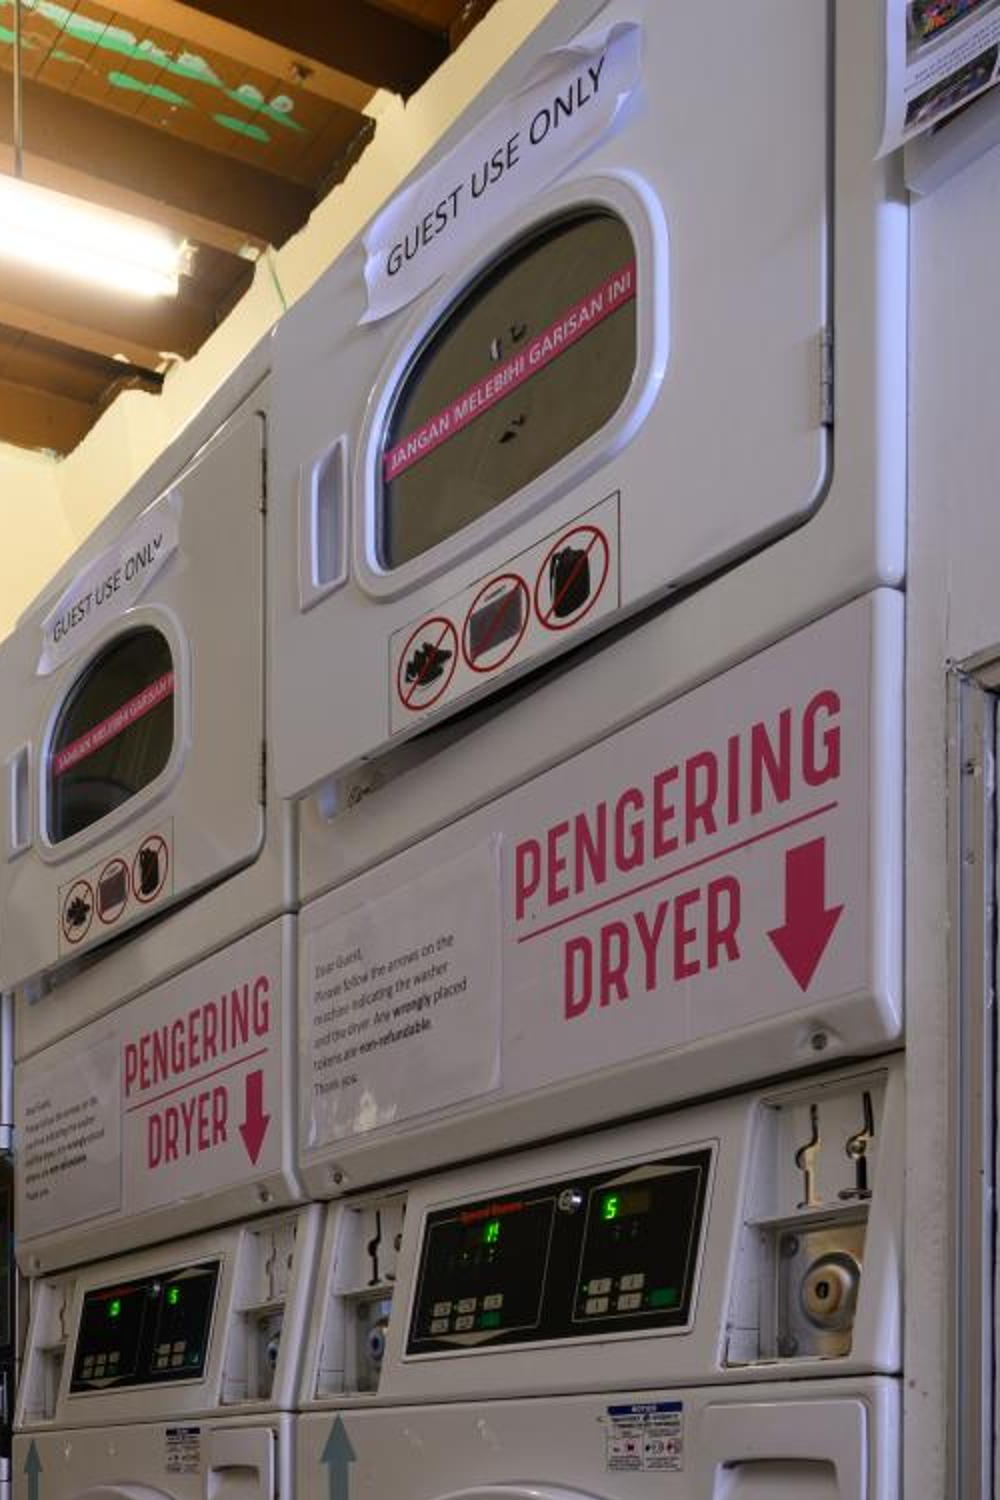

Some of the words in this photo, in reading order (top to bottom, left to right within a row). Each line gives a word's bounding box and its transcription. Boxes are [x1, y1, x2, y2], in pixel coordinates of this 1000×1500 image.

[387, 184, 464, 277] GUEST
[470, 132, 520, 199] USE
[530, 57, 605, 146] ONLY
[391, 417, 451, 471] JANGAN
[454, 361, 525, 424] MELEBIHI
[529, 296, 604, 365] GARISAN
[607, 270, 631, 307] INI
[53, 593, 93, 642] GUEST
[96, 569, 121, 606] USE
[515, 690, 841, 921] PENGERING
[393, 994, 431, 1017] wrongly
[433, 976, 467, 1004] placed
[565, 875, 741, 1021] DRYER
[124, 975, 269, 1098] PENGERING
[149, 1086, 228, 1169] DRYER
